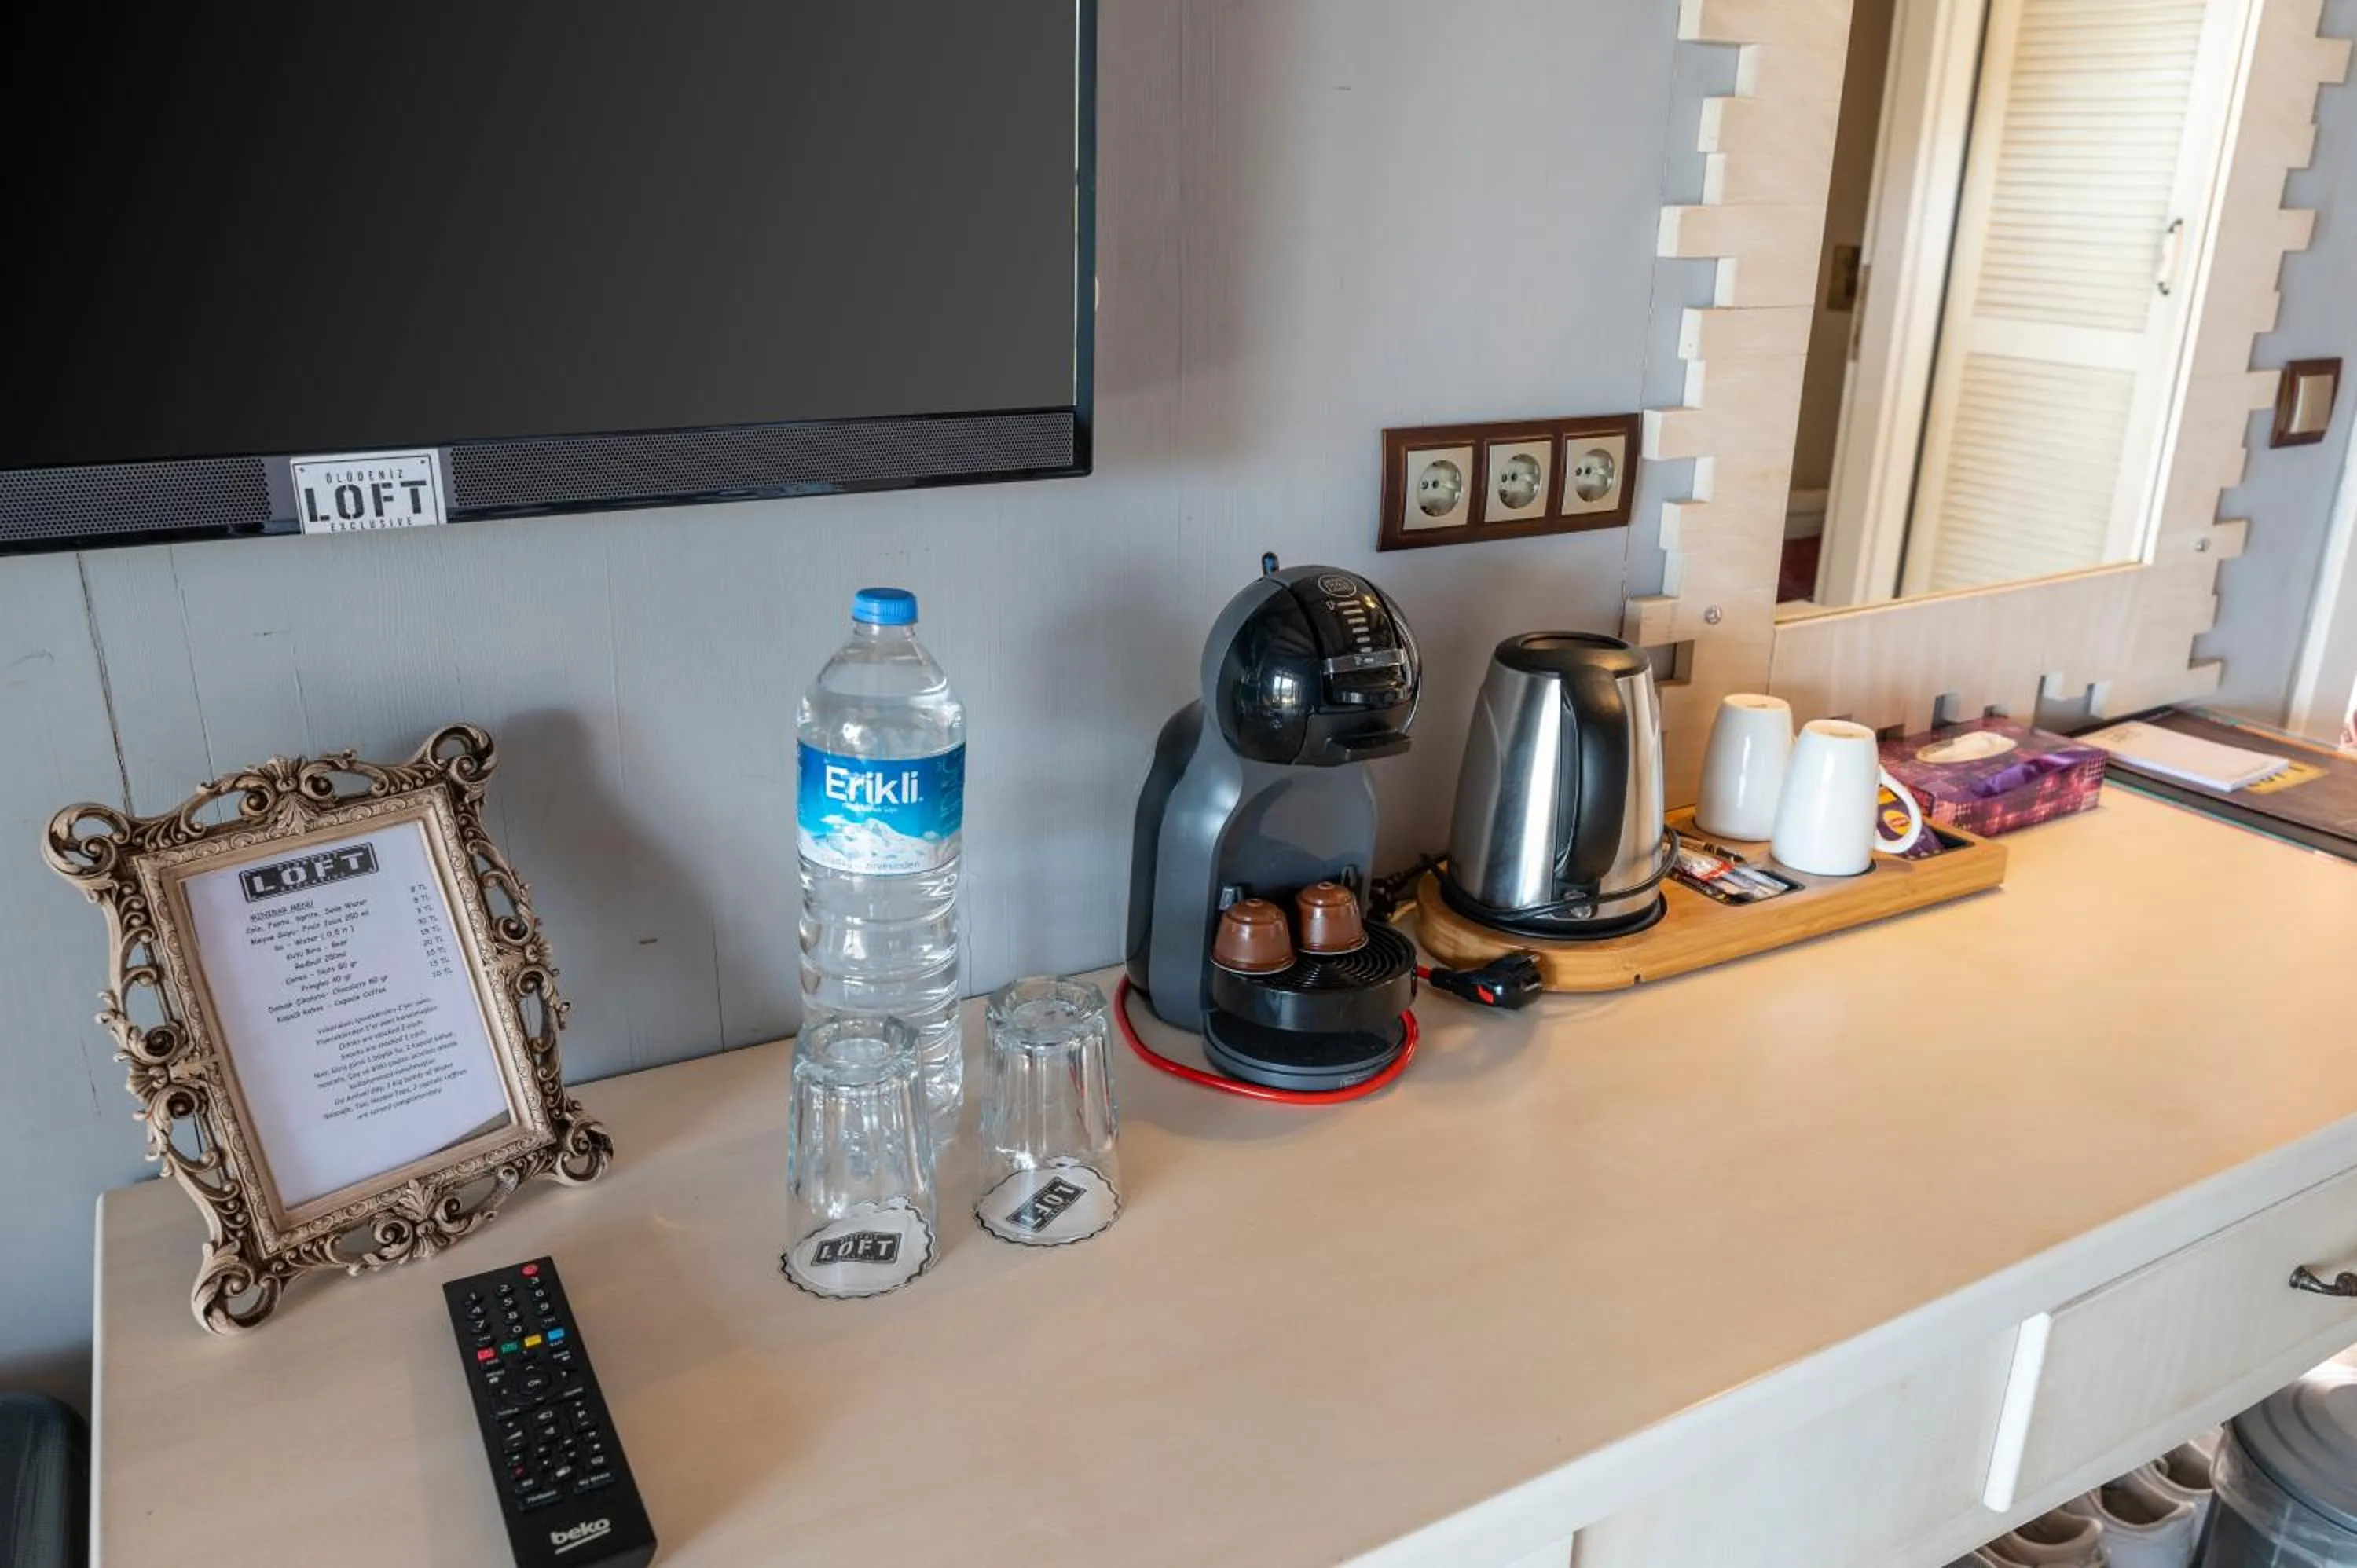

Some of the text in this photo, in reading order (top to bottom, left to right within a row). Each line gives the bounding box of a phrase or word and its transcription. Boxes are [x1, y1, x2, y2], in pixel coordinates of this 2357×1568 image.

[304, 480, 427, 522] LOFT
[331, 517, 412, 532] EXCLUSIVE
[826, 764, 918, 804] Erikli
[252, 852, 364, 893] LOFT
[819, 1240, 893, 1259] LOFT
[527, 1379, 541, 1387] OK
[550, 1518, 610, 1546] beko
